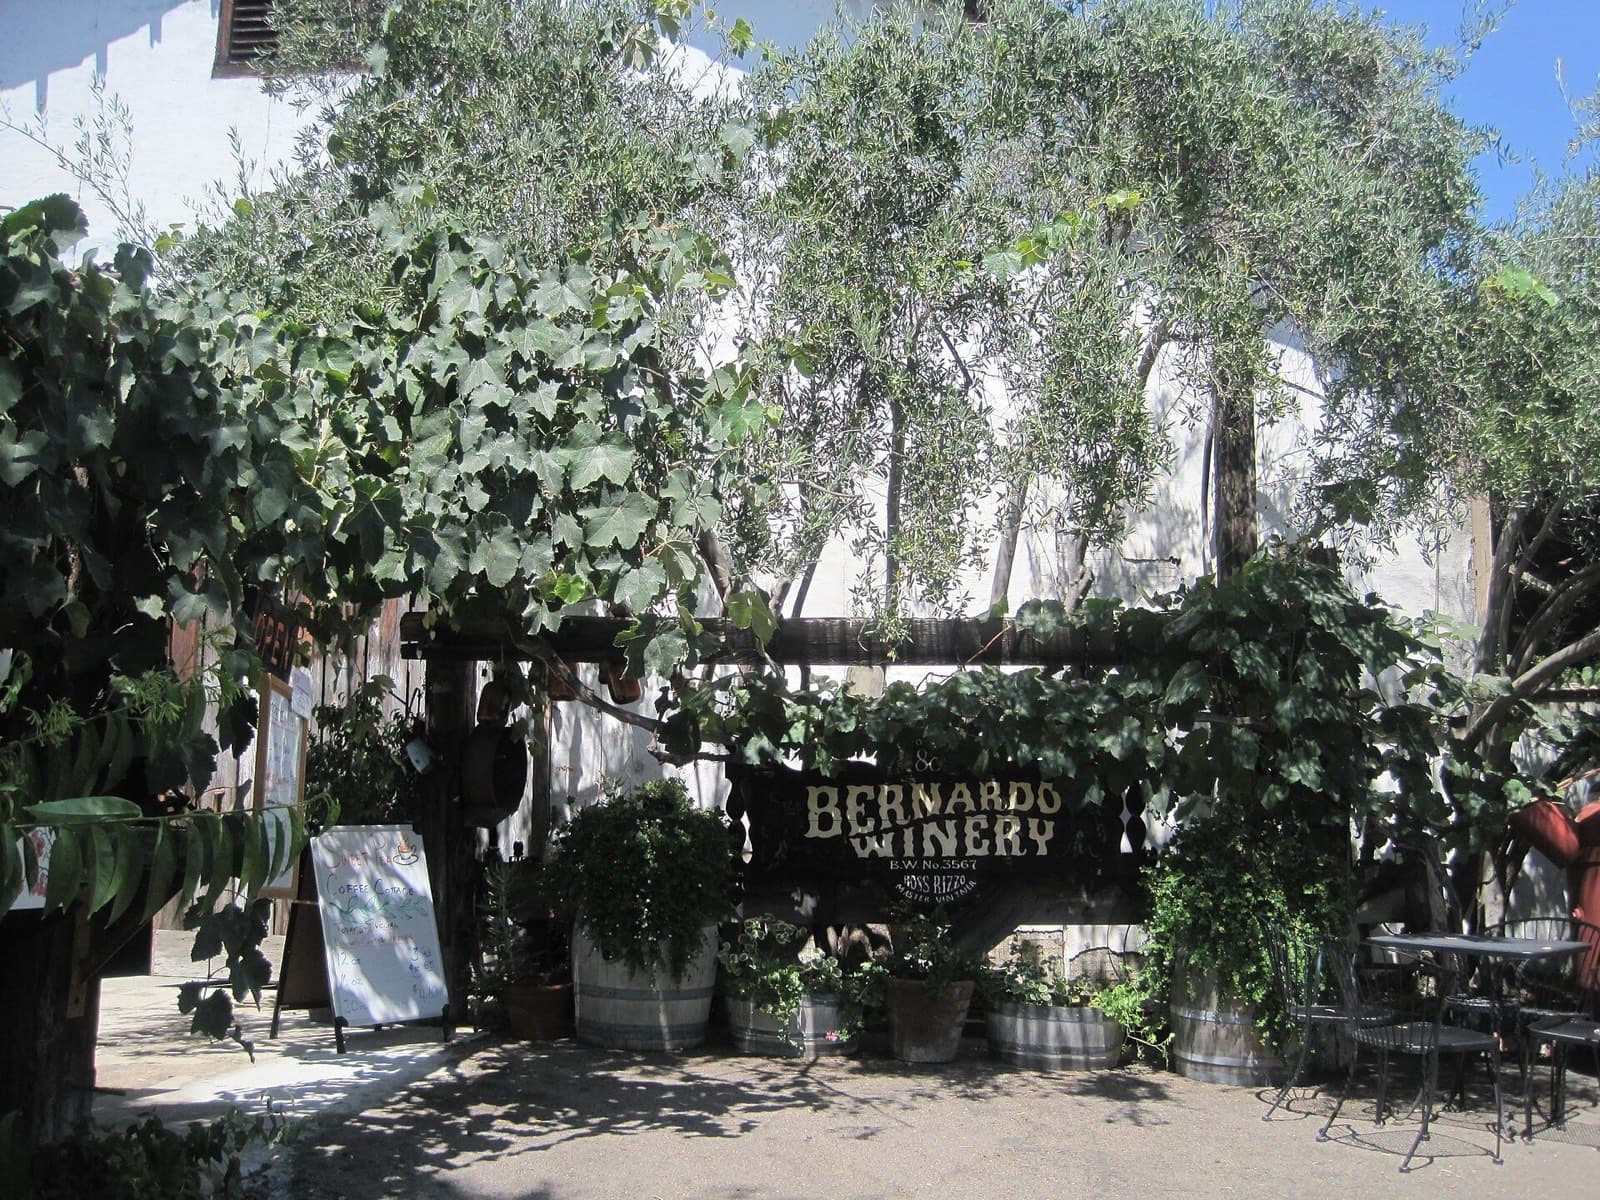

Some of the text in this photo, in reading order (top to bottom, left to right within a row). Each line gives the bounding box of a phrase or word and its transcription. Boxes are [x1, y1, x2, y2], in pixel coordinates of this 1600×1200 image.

[803, 780, 1062, 839] BERNARDO
[849, 815, 1055, 858] WINERY
[933, 874, 966, 894] RIZZO
